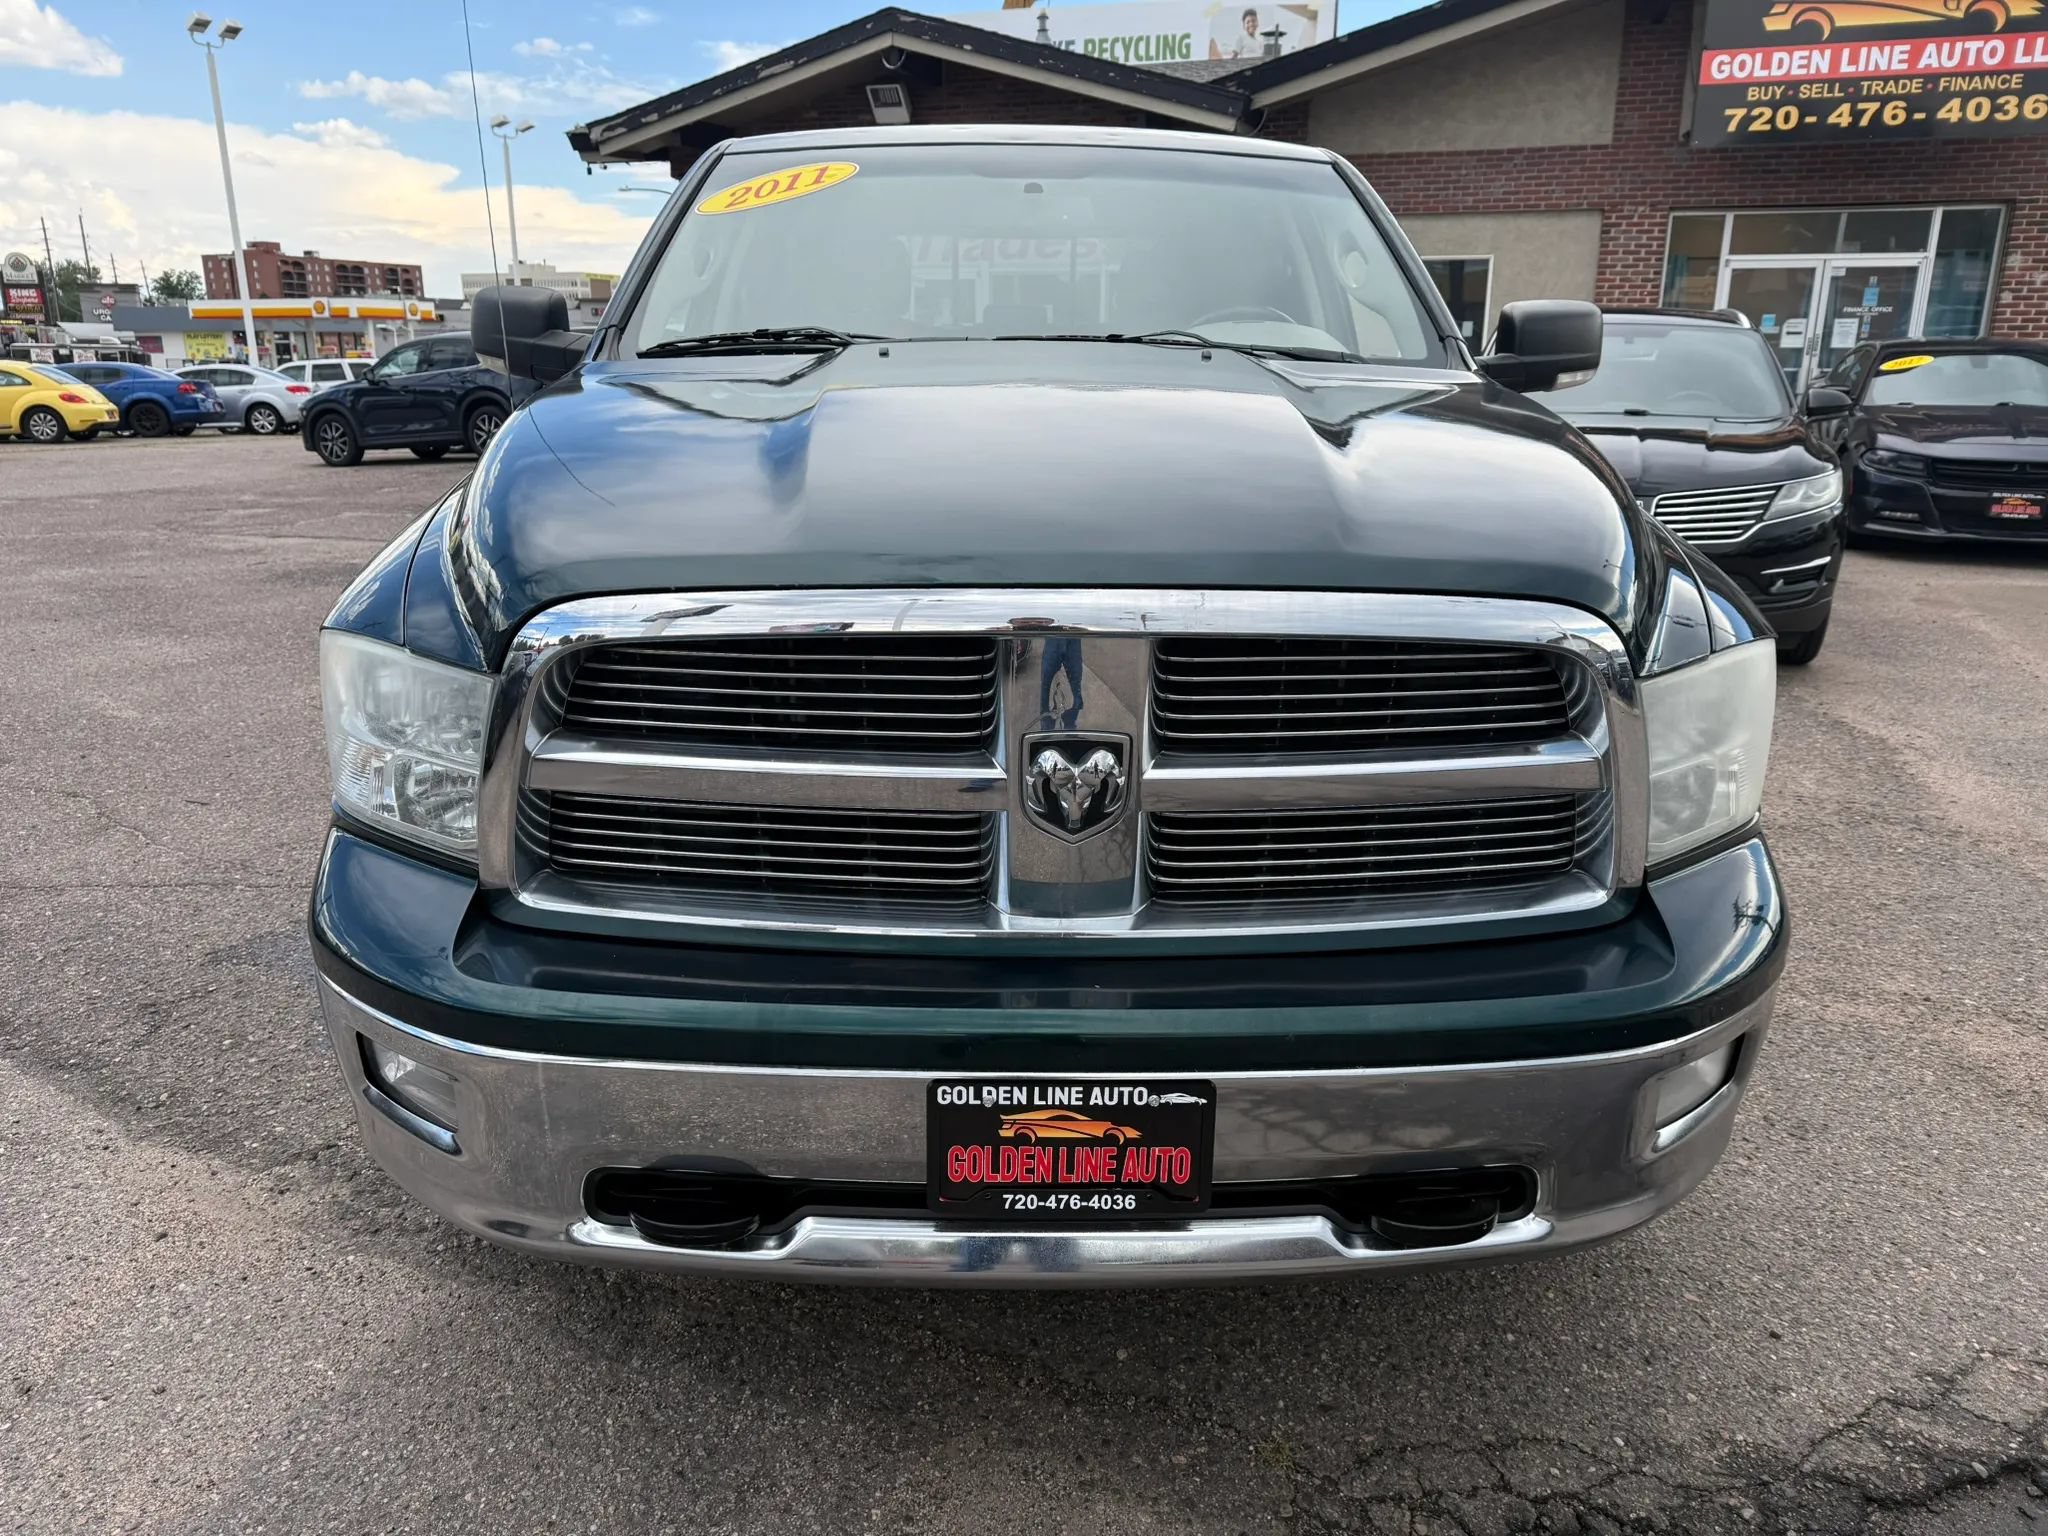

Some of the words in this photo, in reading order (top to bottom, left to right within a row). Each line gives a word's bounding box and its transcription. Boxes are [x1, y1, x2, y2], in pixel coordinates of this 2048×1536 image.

[1083, 32, 1191, 64] RECYCLING
[1711, 49, 1831, 80] GOLDEN
[1840, 43, 1911, 73] LINE
[1917, 39, 2005, 69] AUTO
[1747, 85, 1785, 101] BUY
[1799, 82, 1844, 98] SELL
[1860, 78, 1924, 96] TRADE
[1939, 73, 2024, 92] FINANCE
[724, 165, 829, 209] 2011
[937, 1085, 1027, 1106] GOLDEN
[1034, 1086, 1083, 1105] LINE
[1089, 1086, 1149, 1105] AUTO
[948, 1145, 1051, 1183] GOLDEN
[1058, 1146, 1116, 1184] LINE
[1121, 1147, 1191, 1184] AUTO
[1002, 1194, 1136, 1210] 720-476-4036
